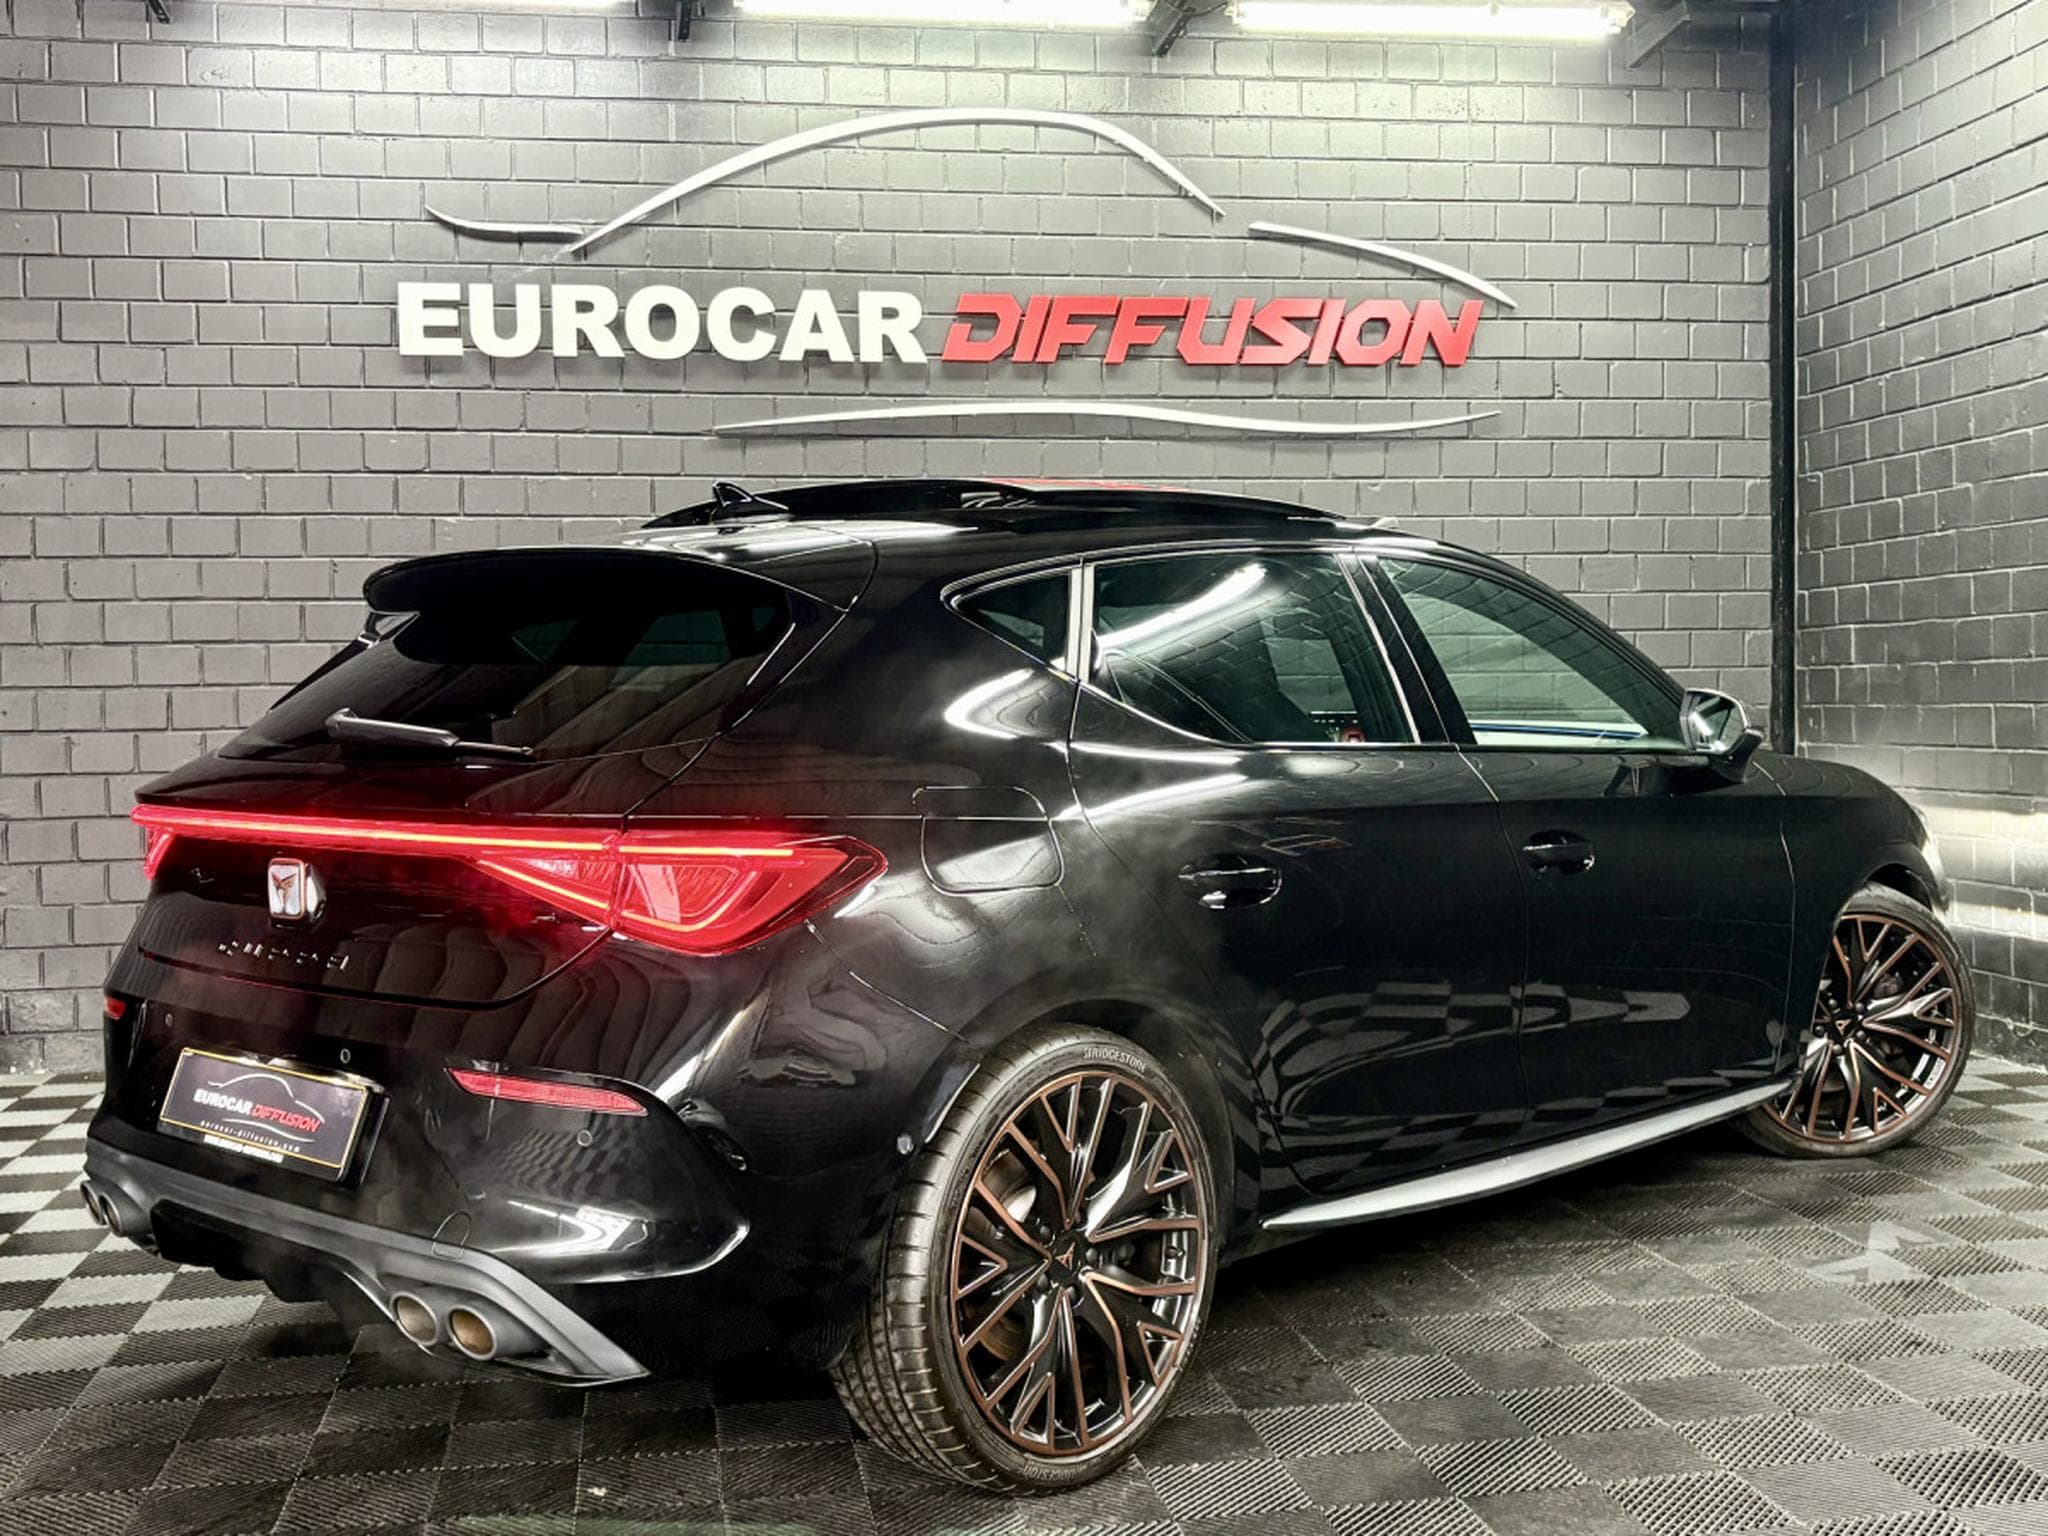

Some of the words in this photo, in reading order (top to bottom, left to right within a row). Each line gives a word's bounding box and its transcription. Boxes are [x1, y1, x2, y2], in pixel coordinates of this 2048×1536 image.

[397, 282, 928, 364] EUROCAR
[942, 293, 1484, 368] DIFFUSION
[193, 1088, 253, 1115] EUROCAR
[252, 1104, 321, 1132] DIFFUSION
